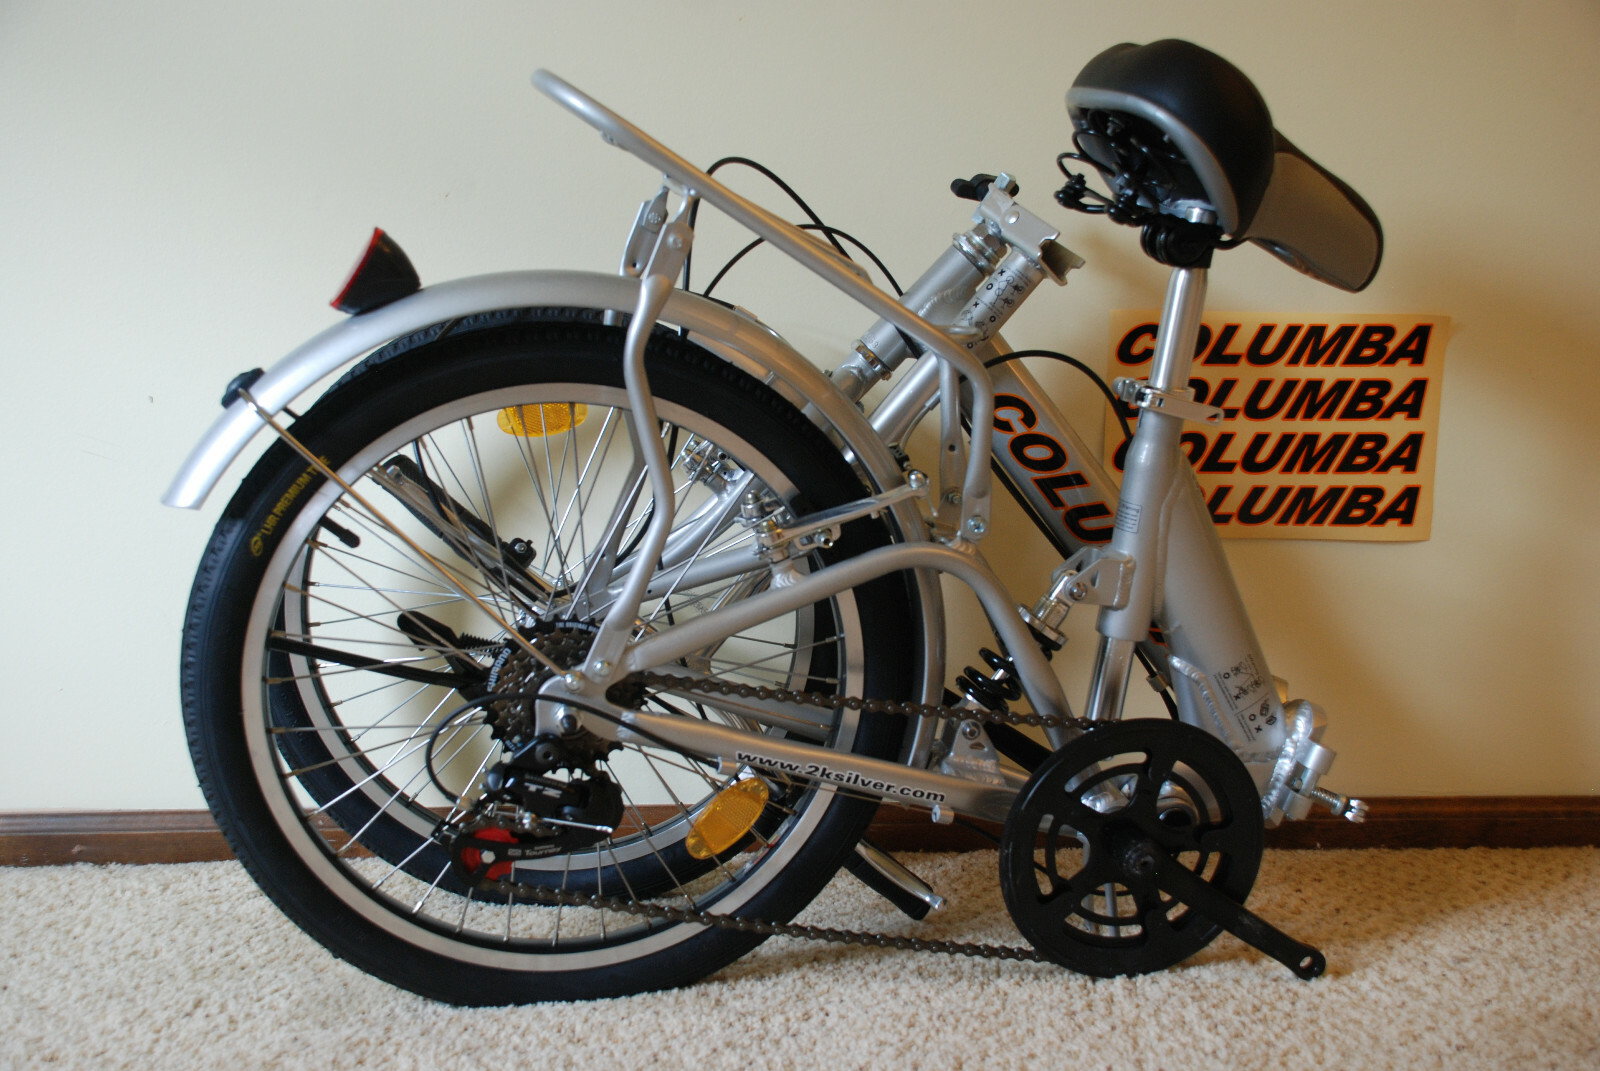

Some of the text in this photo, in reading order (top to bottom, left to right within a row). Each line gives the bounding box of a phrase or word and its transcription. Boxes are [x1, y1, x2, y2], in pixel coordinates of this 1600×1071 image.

[1115, 322, 1434, 367] CLUMBA
[993, 393, 1115, 544] COLU
[273, 472, 313, 517] PREMIUM
[1200, 484, 1422, 528] LUMBA
[487, 647, 512, 692] SHIMANO
[524, 782, 562, 798] TZ
[735, 751, 947, 803] www.2ksilver.com
